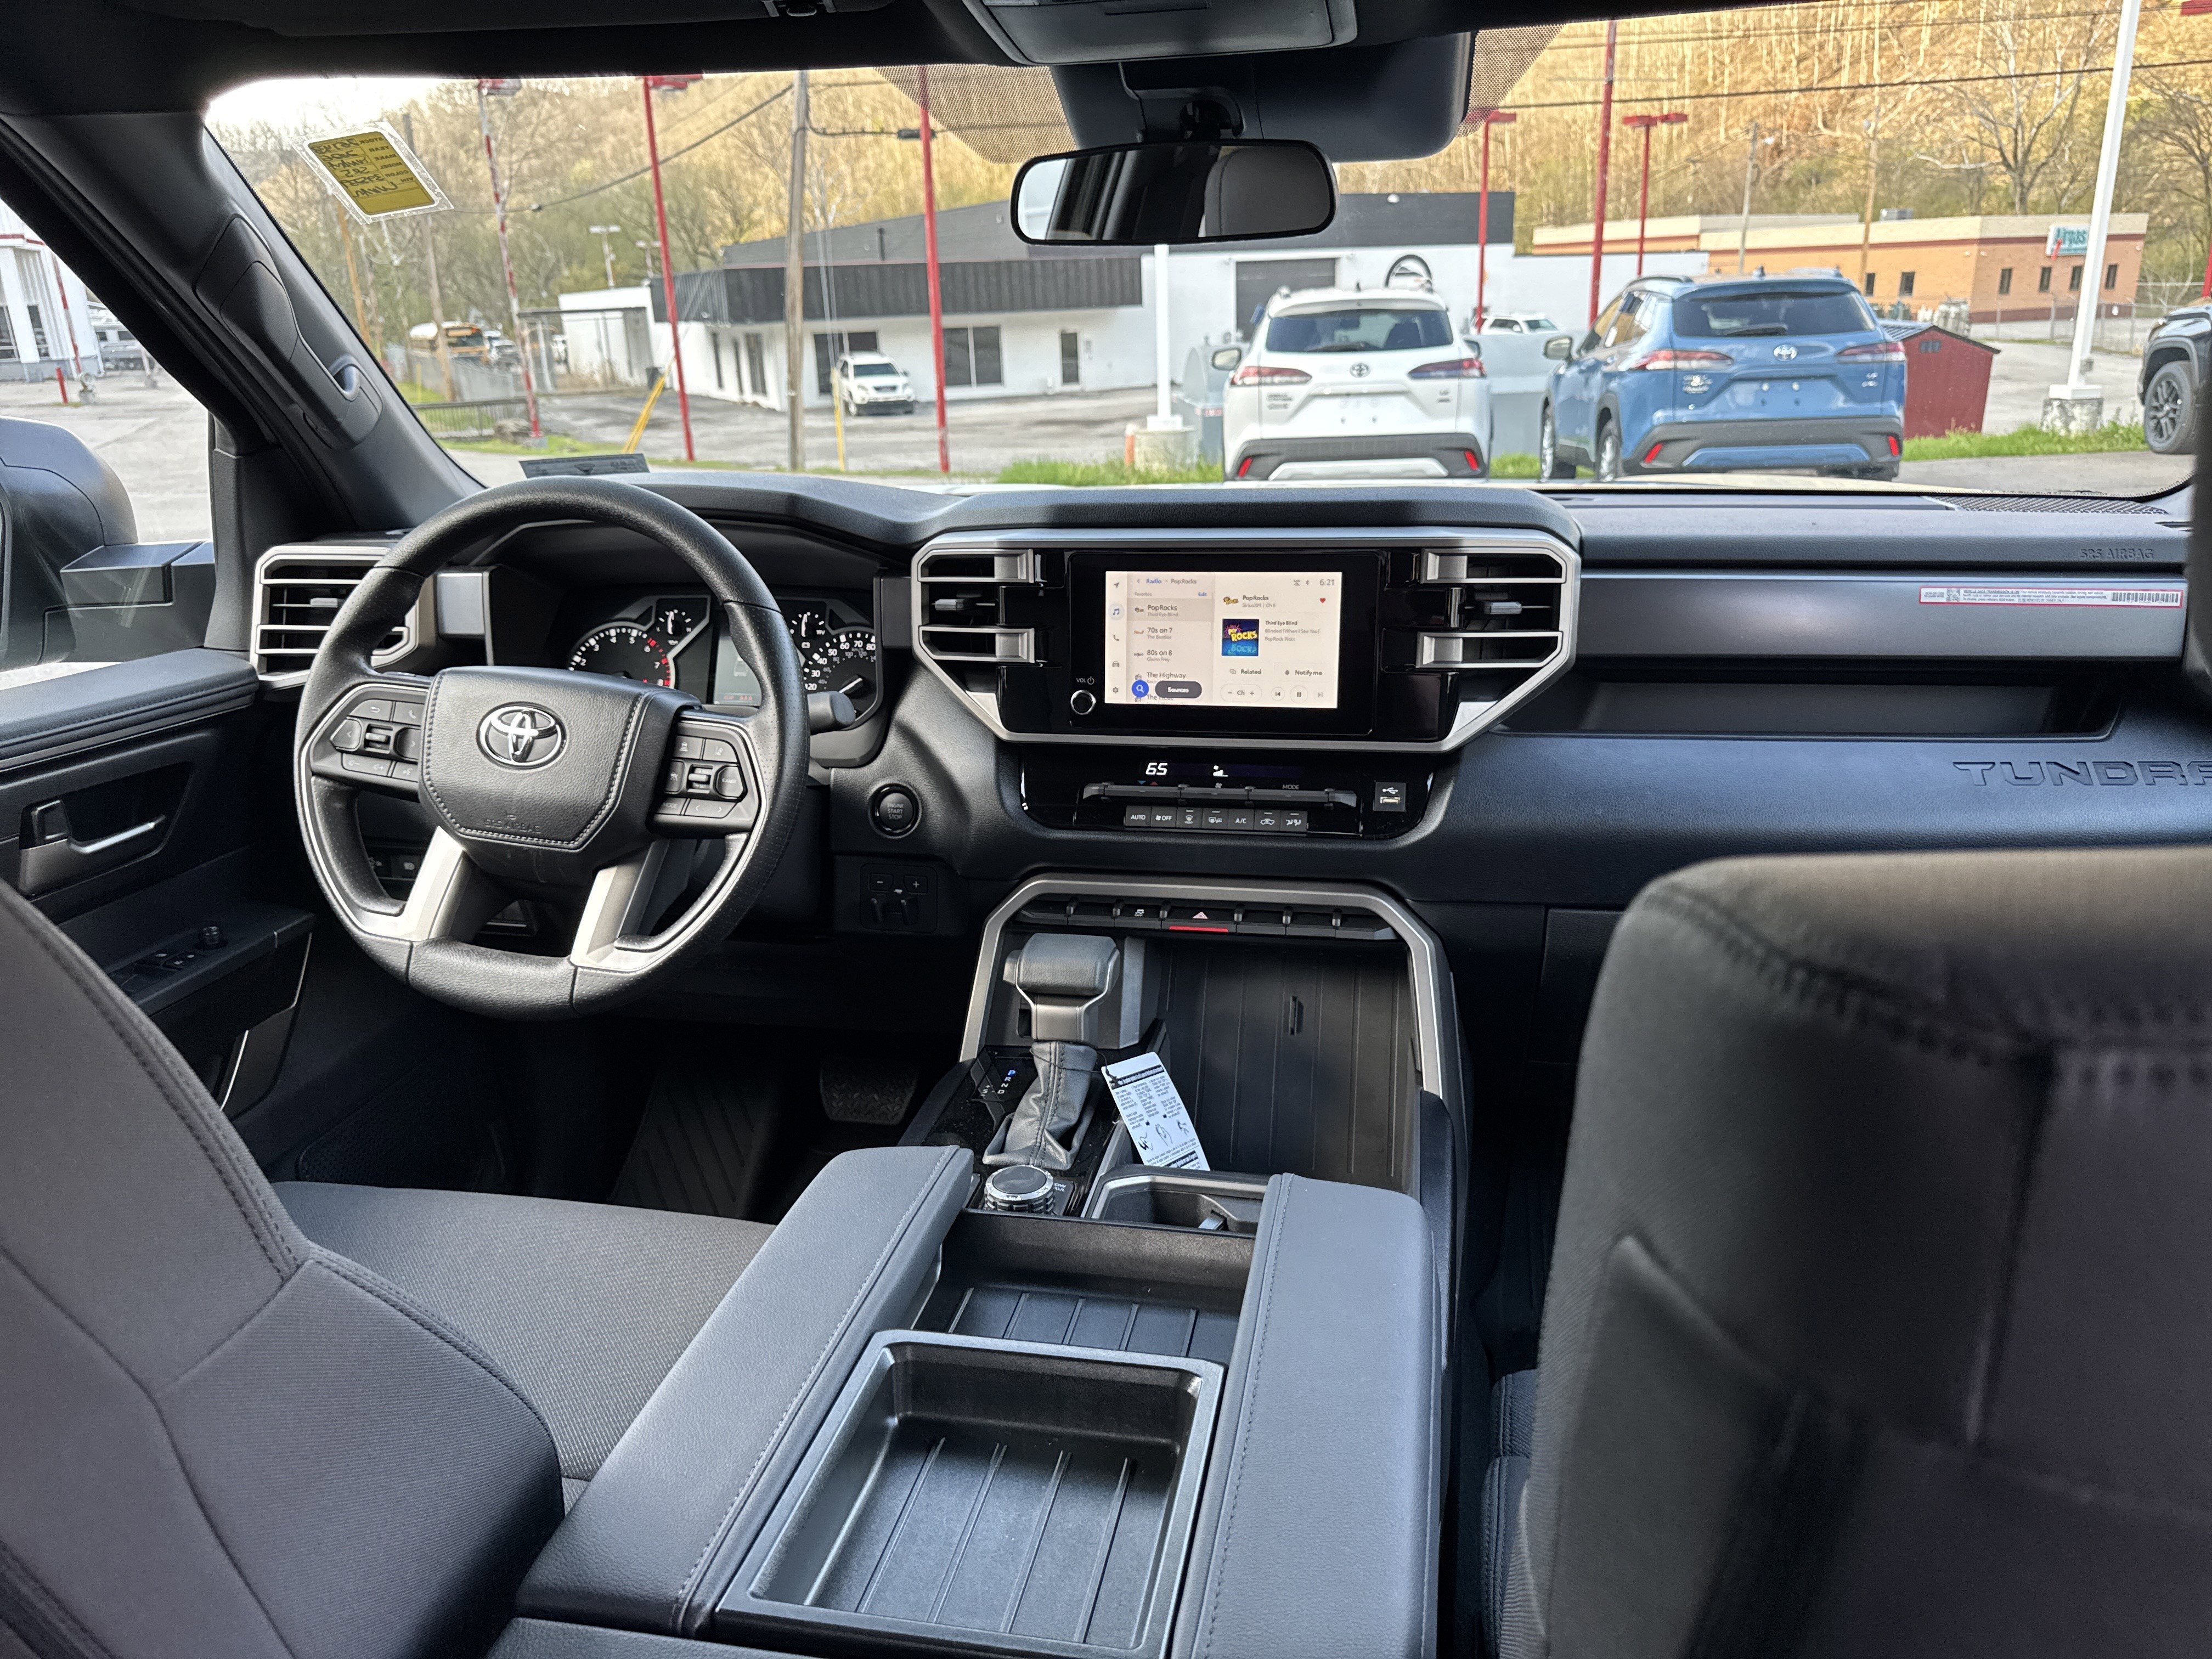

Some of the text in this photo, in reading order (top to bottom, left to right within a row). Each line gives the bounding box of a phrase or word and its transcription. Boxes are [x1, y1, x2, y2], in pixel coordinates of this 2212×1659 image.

[2080, 549, 2154, 558] SRS AIRBAG
[1231, 630, 1257, 642] ROCKS
[594, 644, 600, 652] 3
[1146, 762, 1168, 776] 65
